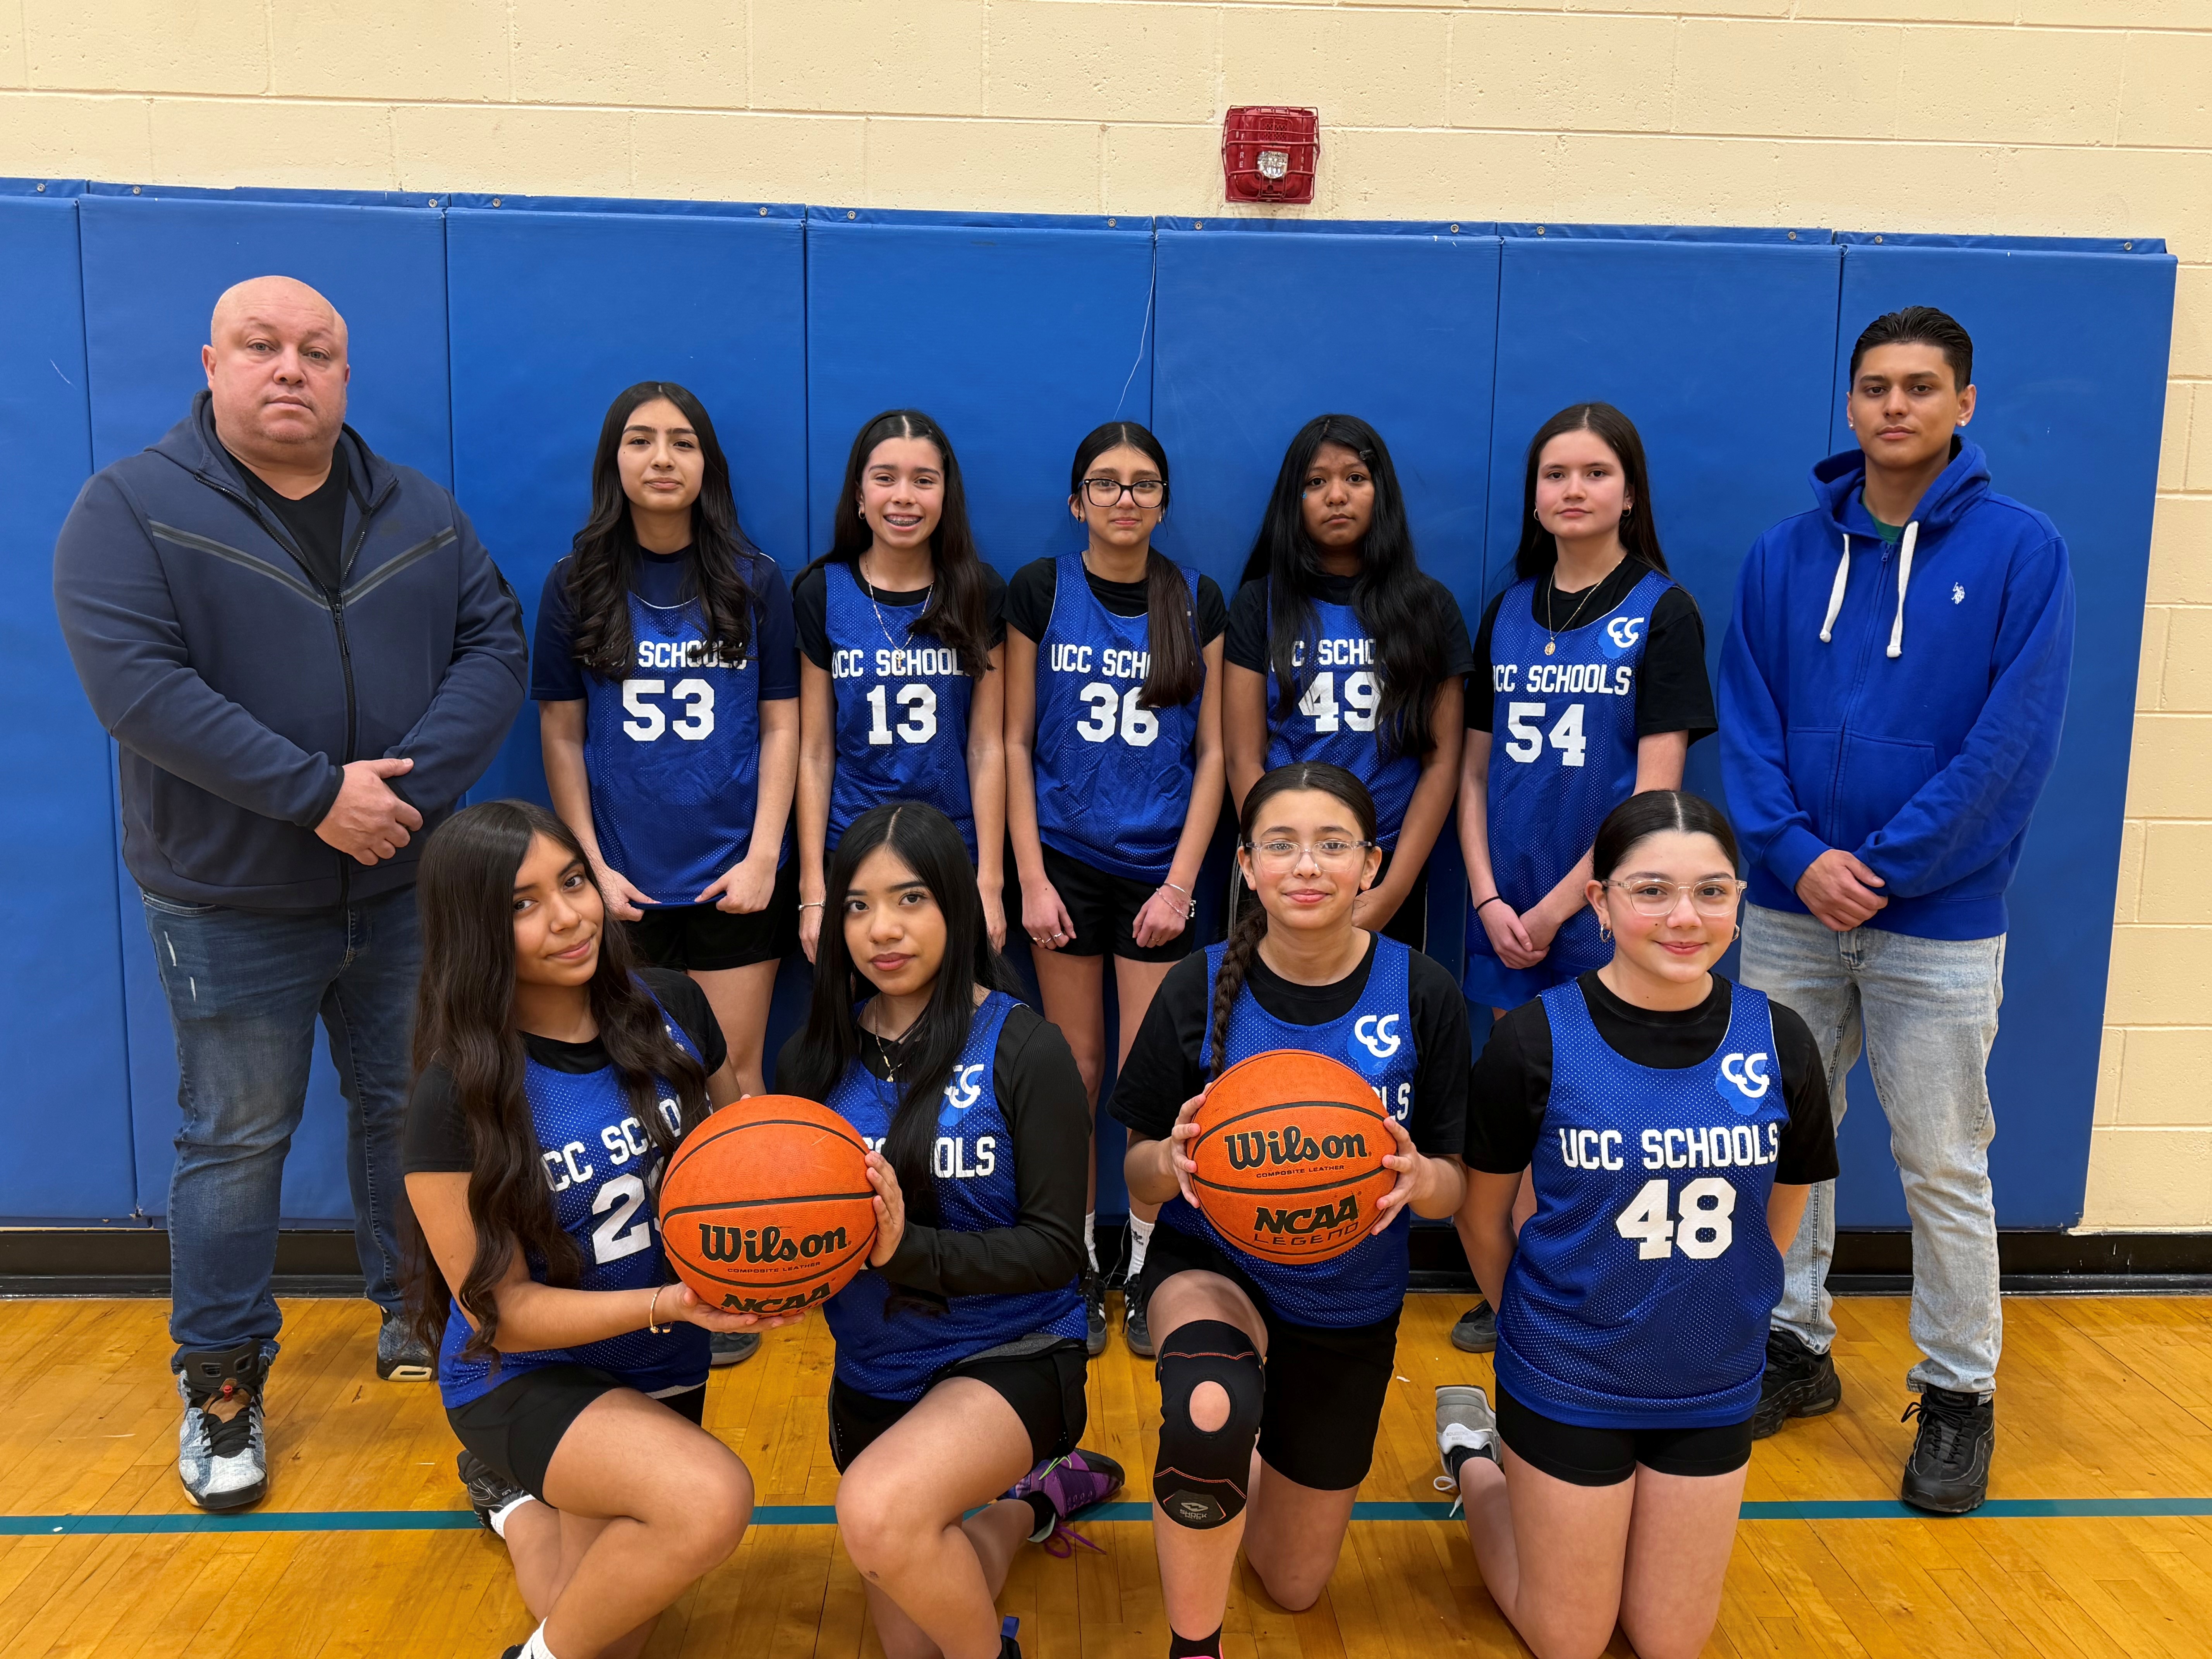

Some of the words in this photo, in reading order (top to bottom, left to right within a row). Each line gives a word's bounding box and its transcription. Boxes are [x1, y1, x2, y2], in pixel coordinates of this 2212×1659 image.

[876, 648, 970, 677] SCHOOL
[1051, 644, 1092, 673] UCC
[1102, 649, 1151, 680] SCH
[1526, 664, 1632, 696] SCHOOLS
[623, 679, 714, 741] 53
[867, 684, 936, 744] 13
[1077, 682, 1159, 747] 36
[1298, 672, 1385, 732] 49
[1506, 702, 1586, 767] 54
[541, 1141, 593, 1192] CC
[931, 1135, 996, 1178] OLS
[1224, 1125, 1367, 1170] Wilson
[1559, 1128, 1623, 1170] UCC
[1641, 1123, 1778, 1169] SCHOOLS
[1256, 1169, 1305, 1178] COMPOSITE
[592, 1156, 665, 1265] 2
[1254, 1194, 1359, 1235] NCAA
[1616, 1177, 1736, 1261] 48
[699, 1223, 848, 1264] Wilson
[1254, 1222, 1359, 1246] LEGEND
[782, 1261, 821, 1272] LEATHER
[720, 1282, 831, 1314] NCAA
[1180, 1509, 1207, 1518] SHOCK
